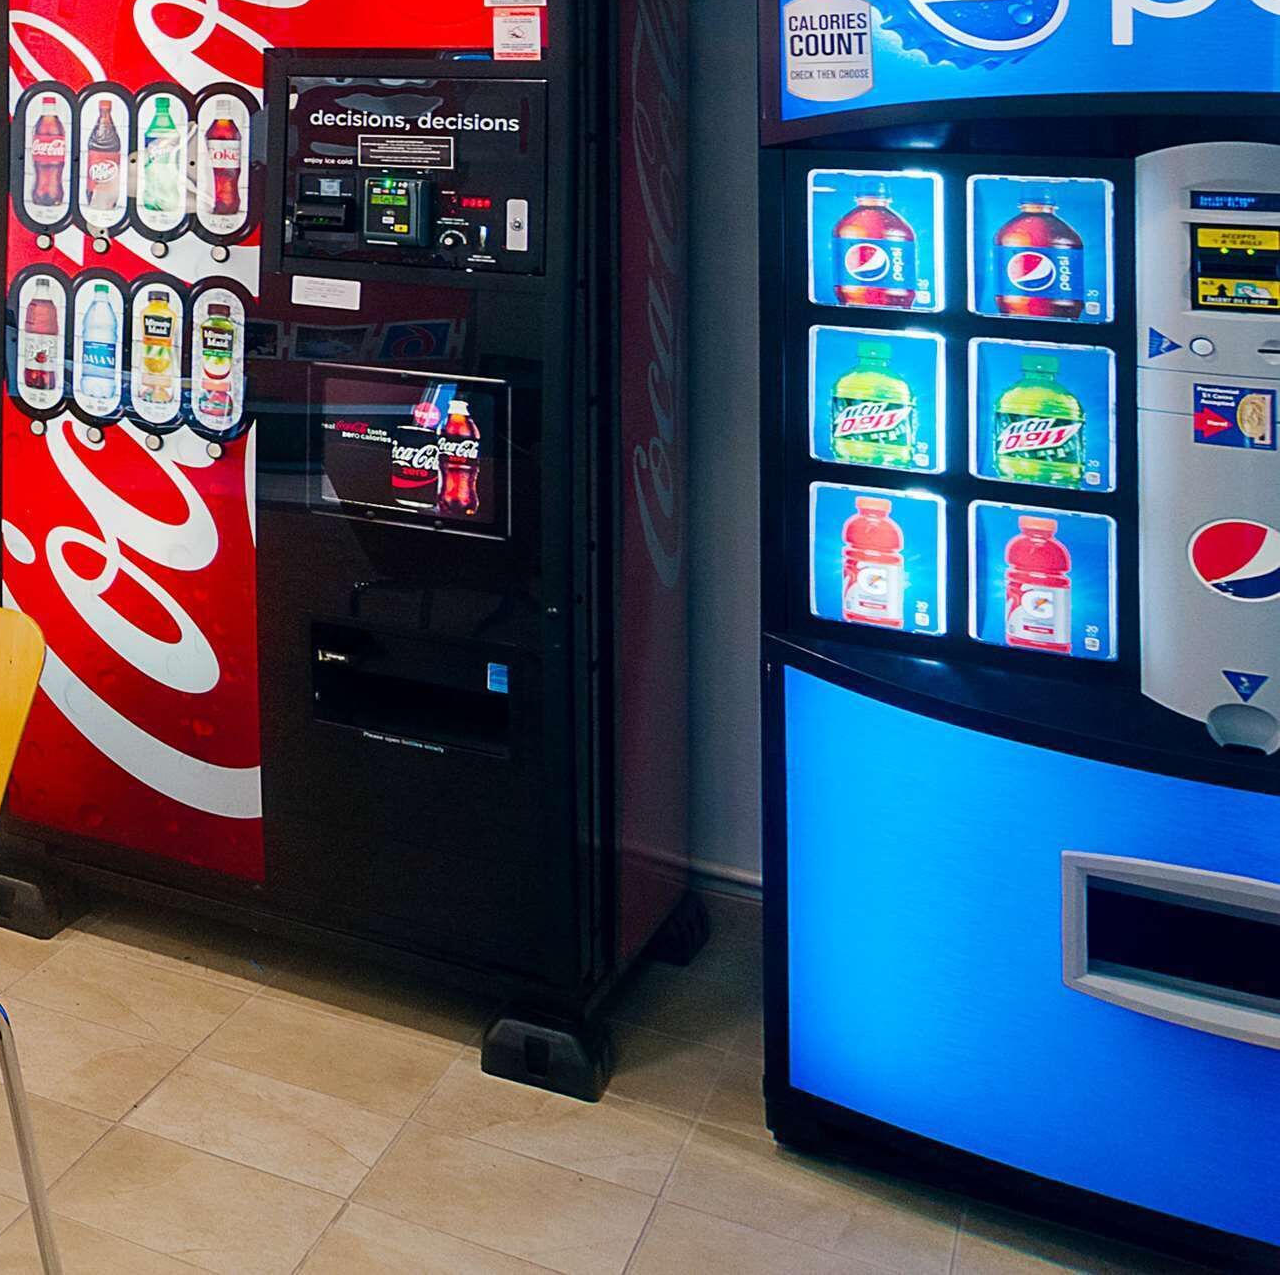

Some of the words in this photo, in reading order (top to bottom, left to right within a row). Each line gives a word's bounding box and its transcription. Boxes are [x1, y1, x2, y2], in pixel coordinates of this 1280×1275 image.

[788, 13, 867, 31] CALORIES
[790, 32, 867, 56] COUNT
[817, 69, 836, 79] THEN
[839, 69, 869, 79] CHOOSE
[310, 110, 410, 130] decisions,
[417, 113, 520, 132] decisions
[892, 247, 905, 282] pepsi
[1058, 256, 1071, 291] pepsi
